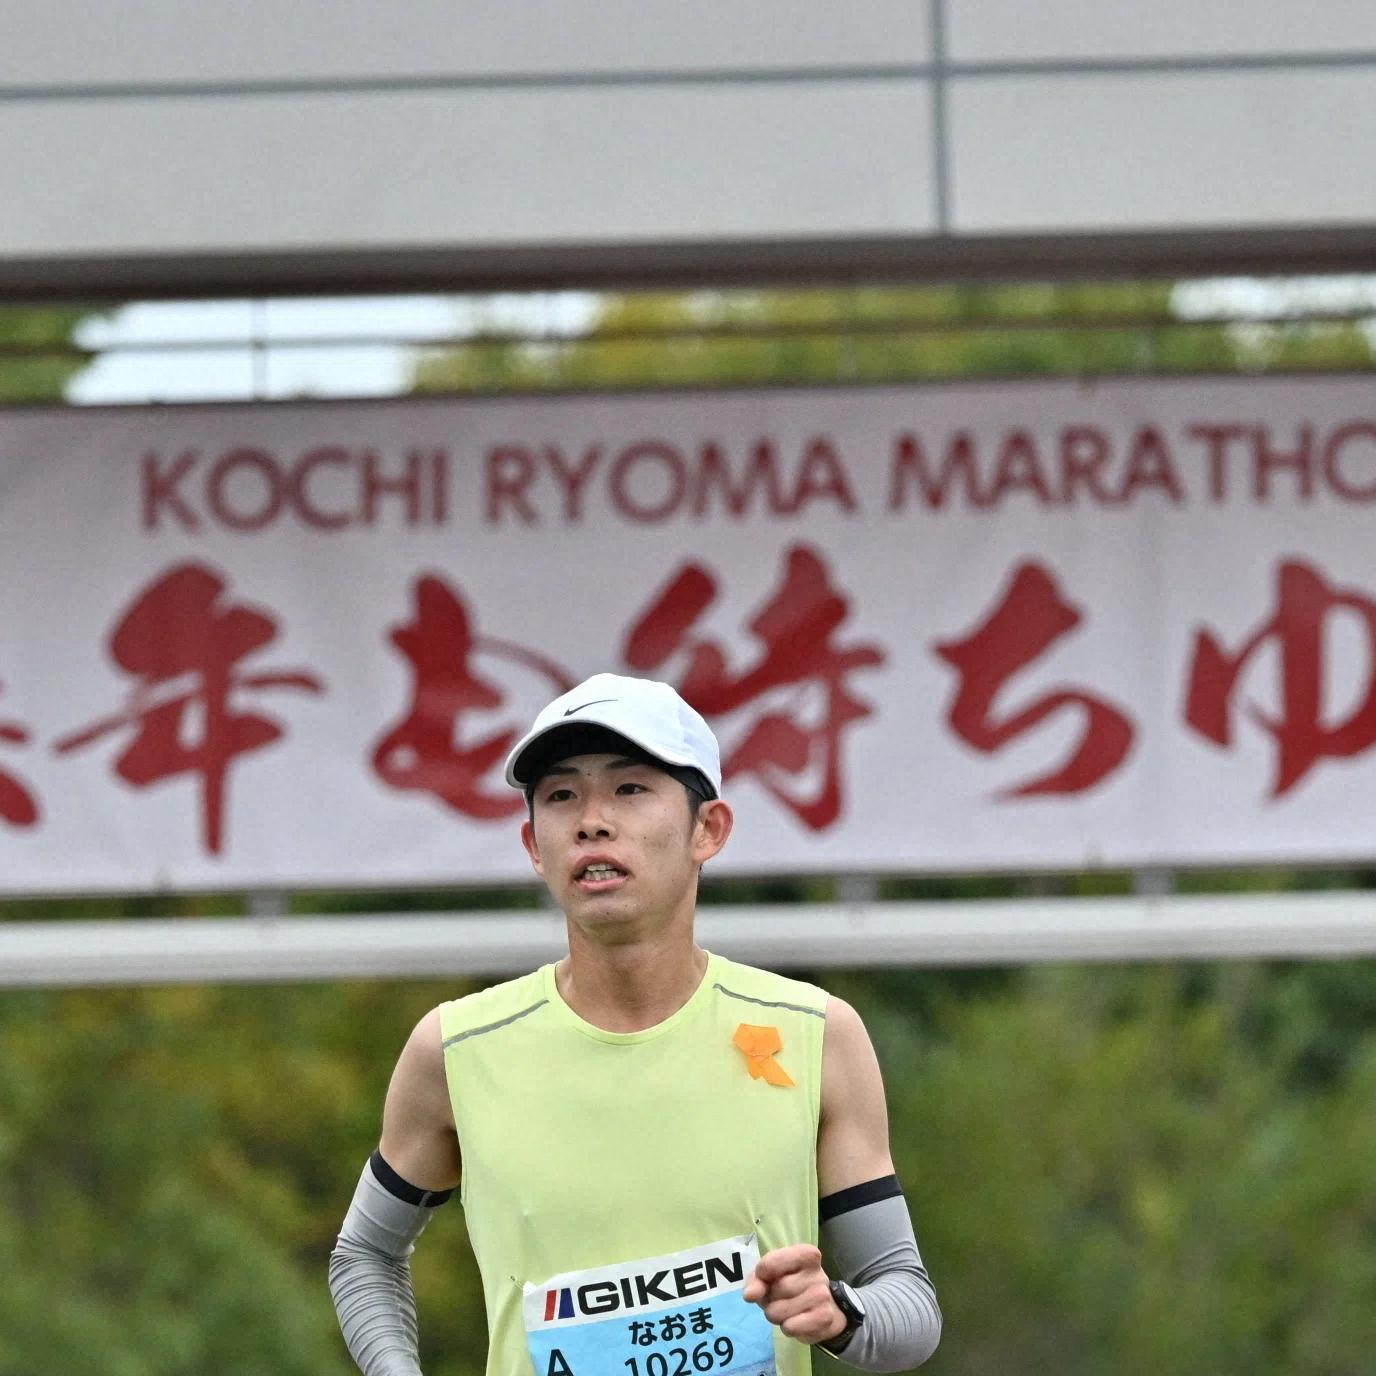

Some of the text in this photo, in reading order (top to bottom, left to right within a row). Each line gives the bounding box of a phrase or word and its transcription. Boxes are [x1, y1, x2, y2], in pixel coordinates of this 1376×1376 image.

[140, 449, 449, 532] KOCHI
[483, 437, 857, 522] RYOMA
[577, 1251, 744, 1316] GIKEN
[628, 1307, 715, 1347] なおま
